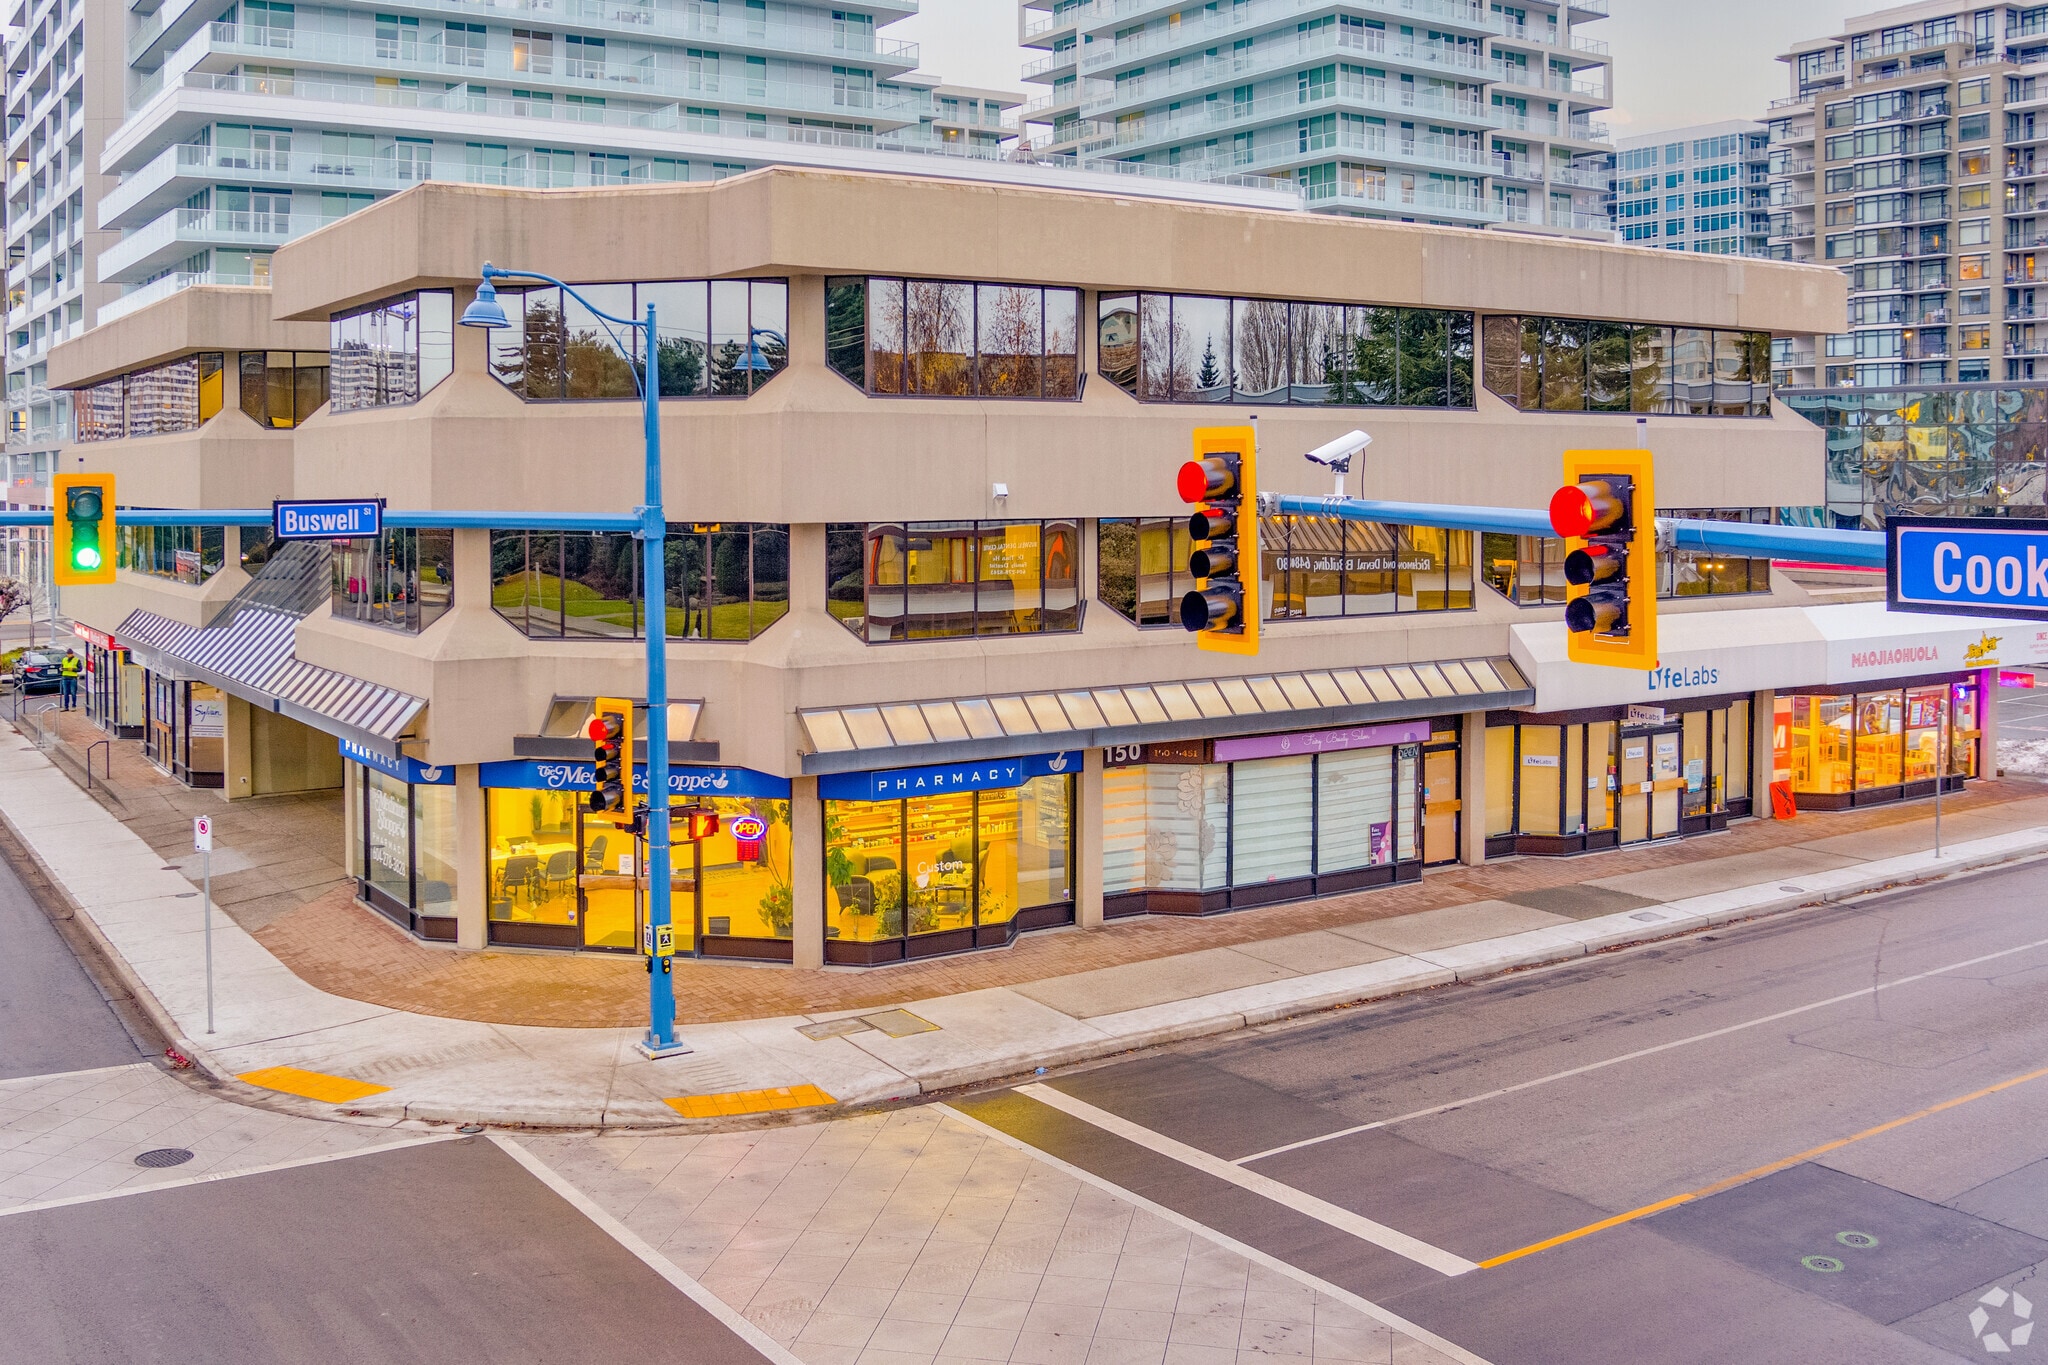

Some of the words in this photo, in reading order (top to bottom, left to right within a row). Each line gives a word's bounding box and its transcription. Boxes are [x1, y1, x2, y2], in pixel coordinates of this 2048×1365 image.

[285, 508, 359, 532] Buswell
[363, 507, 372, 516] St
[1933, 541, 2048, 598] Cook
[1851, 646, 1939, 668] MAOJIAOHUOLA
[345, 739, 400, 771] PHARMACY
[1104, 744, 1141, 763] 150
[878, 767, 1016, 792] PHARMACY
[735, 822, 760, 834] OPEN
[917, 860, 963, 874] Custom
